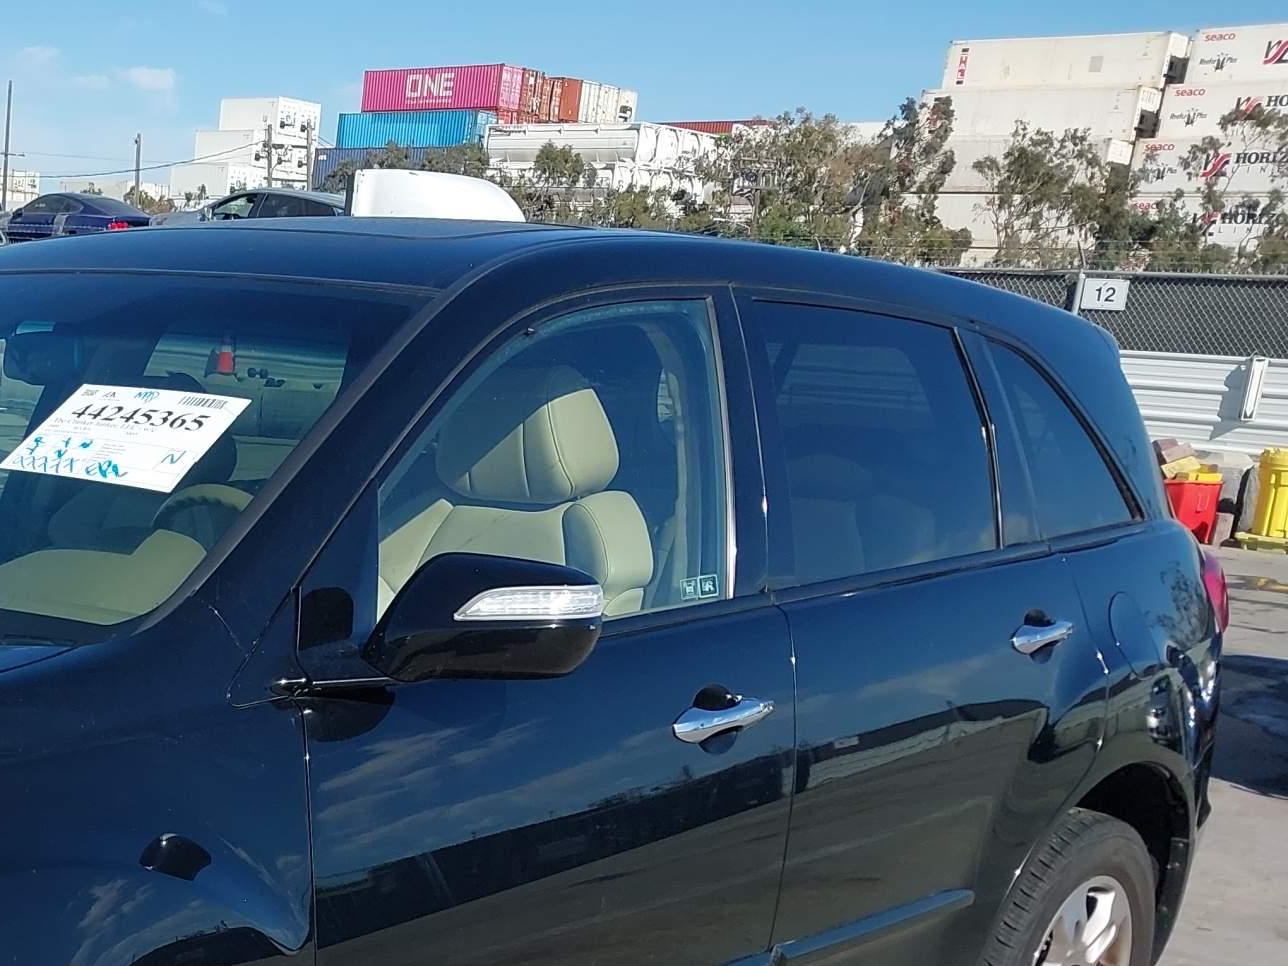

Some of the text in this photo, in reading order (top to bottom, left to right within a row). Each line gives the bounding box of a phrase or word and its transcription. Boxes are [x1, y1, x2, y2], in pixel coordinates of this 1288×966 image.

[1205, 32, 1236, 42] seaco
[406, 72, 454, 97] ONE
[1175, 88, 1206, 97] seaco
[1144, 143, 1175, 151] seaco
[1095, 286, 1116, 302] 12
[71, 403, 211, 432] 44245365
